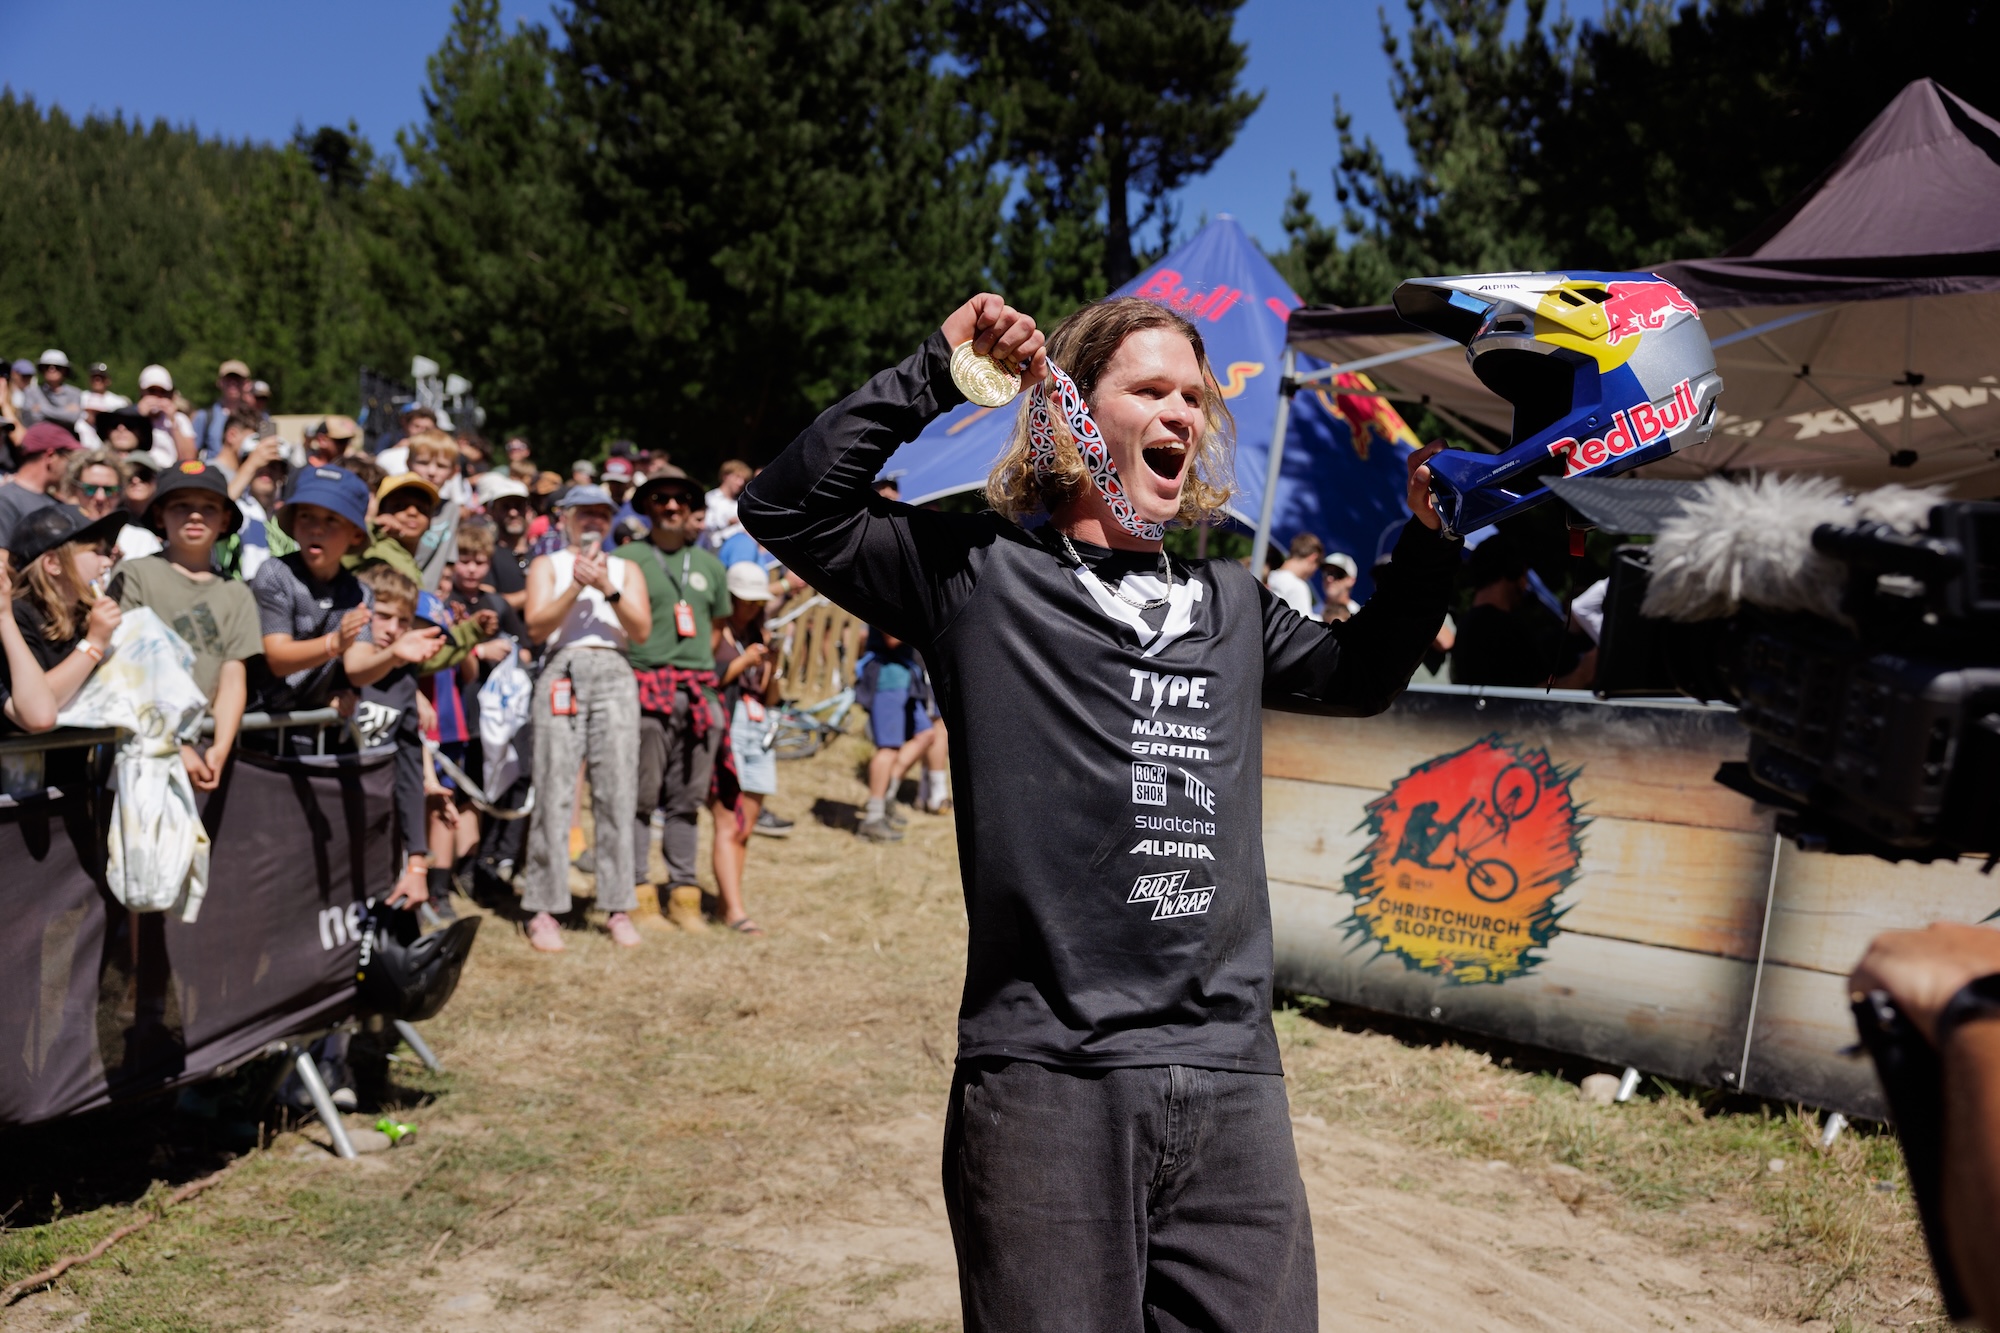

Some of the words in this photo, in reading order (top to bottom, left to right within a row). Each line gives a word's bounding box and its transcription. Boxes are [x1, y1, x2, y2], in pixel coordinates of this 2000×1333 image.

[1136, 268, 1242, 322] Bull
[1549, 410, 1634, 478] Red
[1627, 379, 1699, 443] Bull
[1131, 719, 1207, 741] MAXXIS
[1131, 741, 1210, 760] SRAM
[1135, 765, 1164, 783] ROCK
[1136, 784, 1164, 802] SHOX
[1178, 767, 1216, 815] TITLE
[1134, 815, 1204, 835] swatch
[1129, 839, 1216, 861] ALPINA
[1134, 874, 1183, 899] RIDE
[1161, 891, 1211, 916] WRAP
[1378, 898, 1520, 936] CHRISTCHURCH
[1394, 919, 1498, 950] SLOPESTYLE
